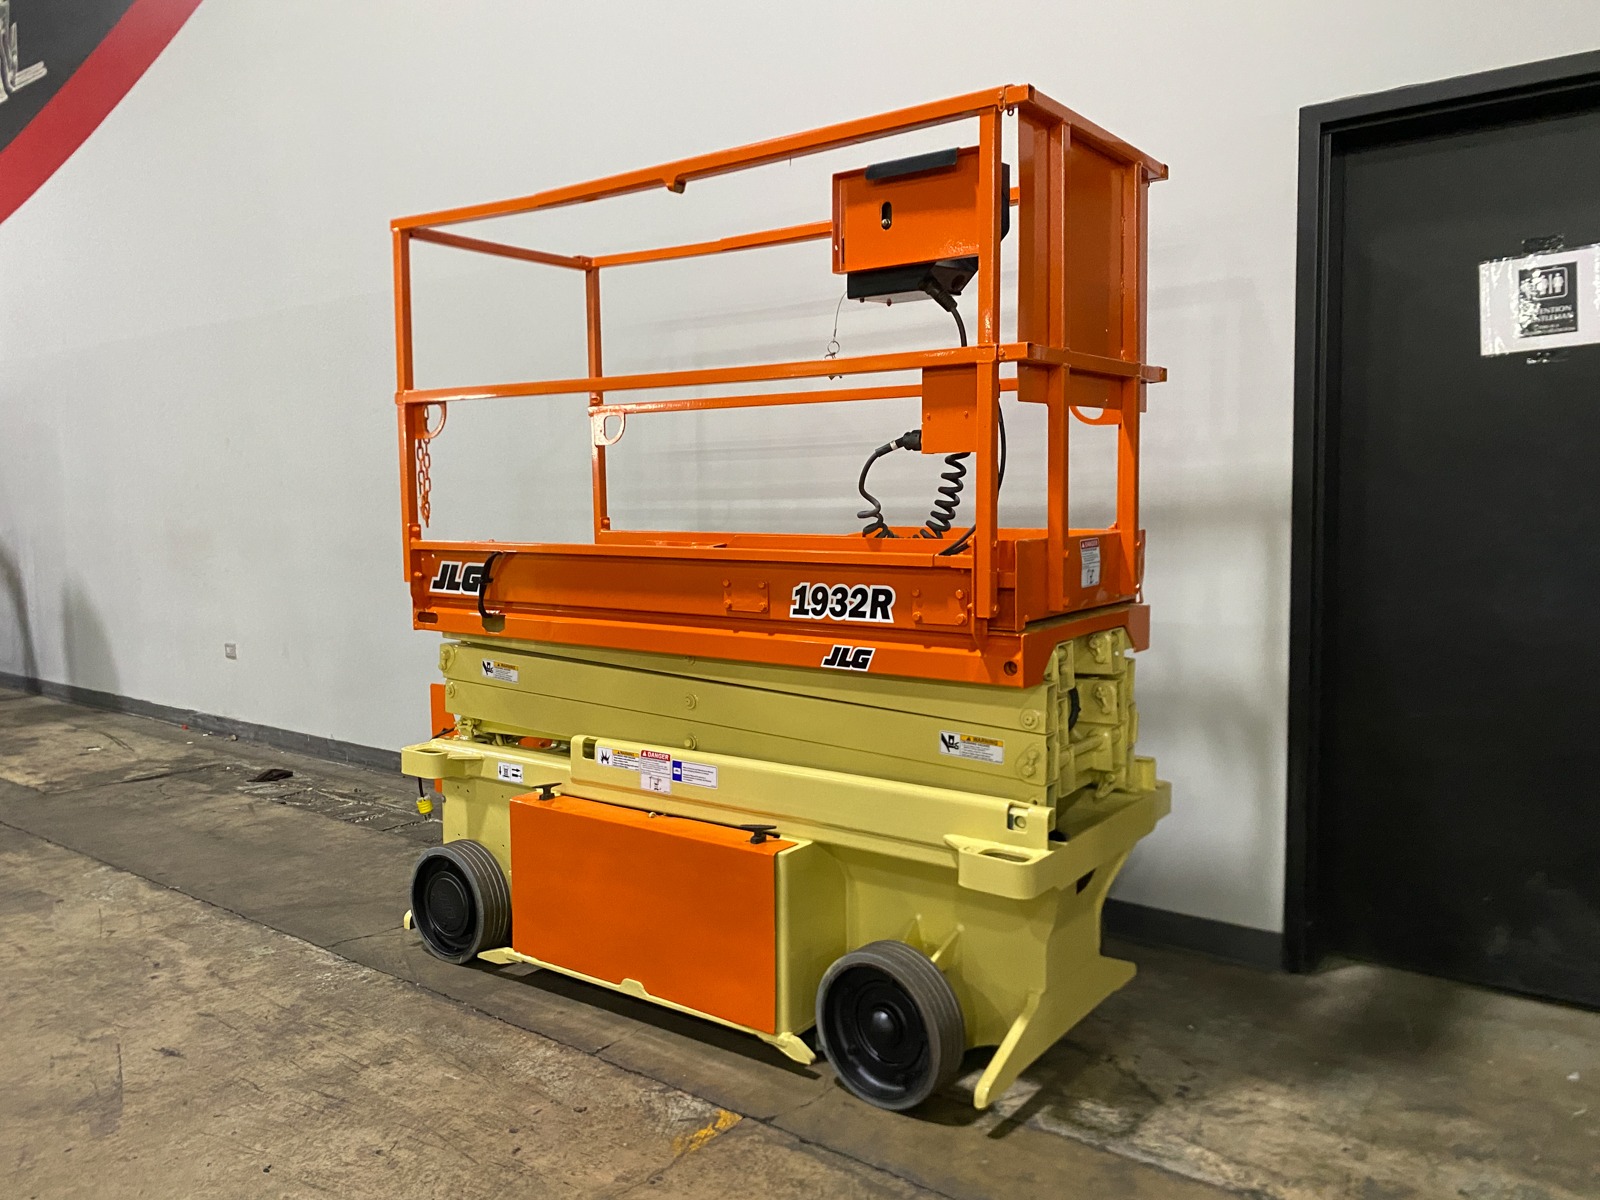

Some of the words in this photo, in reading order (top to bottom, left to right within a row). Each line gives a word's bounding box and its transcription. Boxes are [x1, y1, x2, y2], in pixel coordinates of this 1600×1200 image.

[430, 563, 486, 594] JLG
[791, 584, 893, 620] 1932R
[822, 646, 874, 670] JLG
[647, 750, 670, 760] DANGER
